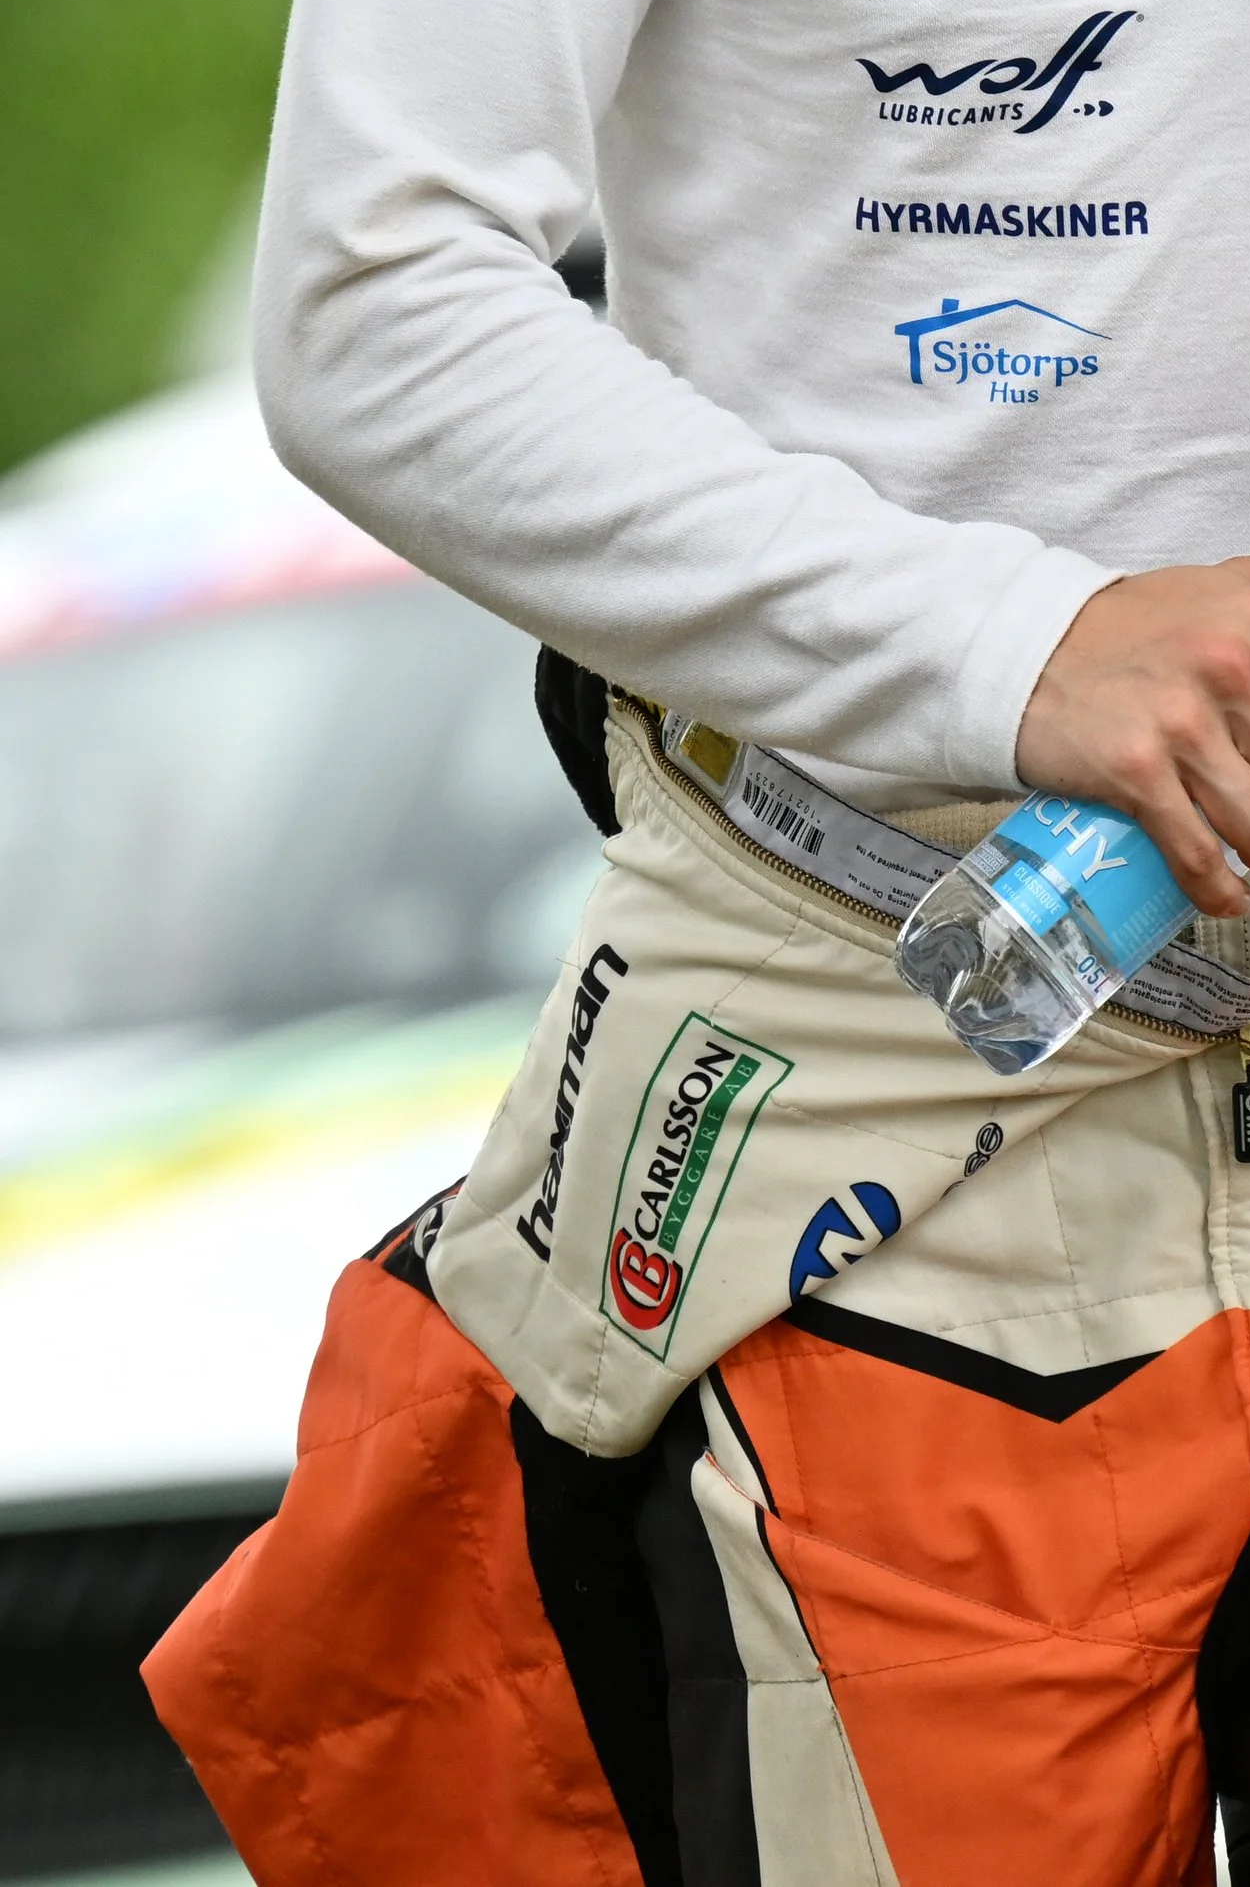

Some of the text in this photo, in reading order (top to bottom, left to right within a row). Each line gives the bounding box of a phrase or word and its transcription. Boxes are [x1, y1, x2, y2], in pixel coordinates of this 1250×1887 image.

[879, 101, 1024, 126] LUBRICANTS
[855, 197, 1149, 237] HYRMASKINER
[932, 340, 1099, 387] Sjötorps
[989, 381, 1040, 404] Hus
[1014, 866, 1062, 915] CLASSIQUE
[633, 1040, 736, 1241] CARLSSON
[662, 1062, 754, 1246] BYGGARE AB
